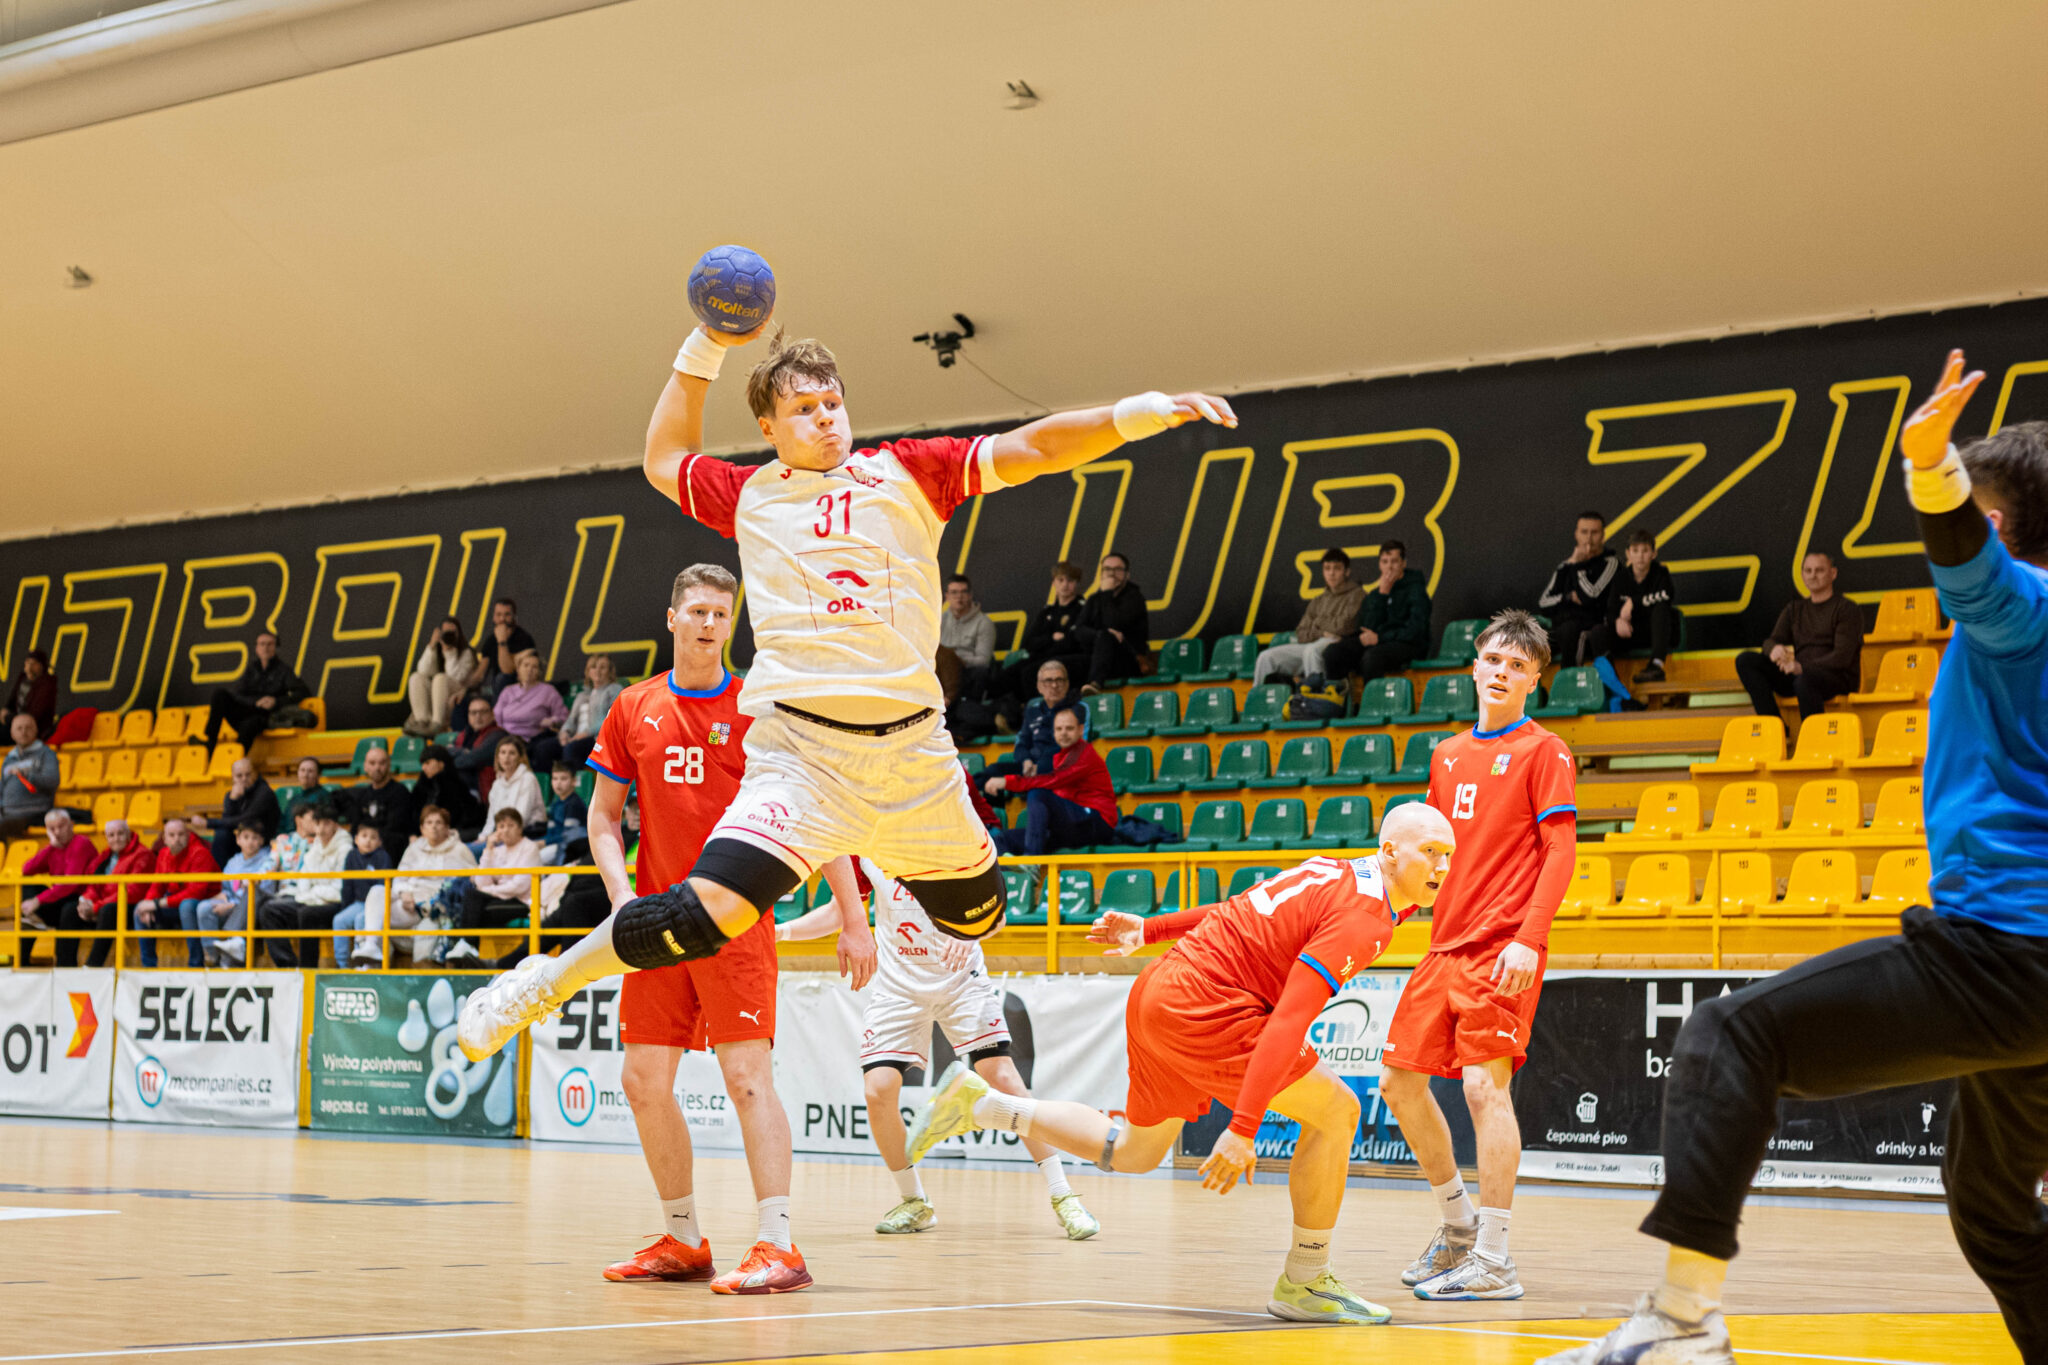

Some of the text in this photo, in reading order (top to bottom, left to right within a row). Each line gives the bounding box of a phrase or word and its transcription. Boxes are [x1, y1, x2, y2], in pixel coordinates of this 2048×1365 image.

[707, 295, 760, 318] molten
[1584, 360, 2048, 612] ZL
[813, 489, 851, 538] 31
[826, 596, 878, 615] ORL
[664, 746, 704, 785] 28
[1452, 783, 1478, 820] 19
[747, 813, 785, 832] ORLEN
[897, 946, 928, 956] ORLEN
[136, 986, 274, 1043] SELECT
[327, 992, 376, 1017] SEPAS
[322, 1054, 423, 1074] Výroba polystyrenu
[1314, 1047, 1384, 1061] MODU
[168, 1073, 272, 1096] mcompanies.cz
[320, 1099, 369, 1116] sepas.cz
[1546, 1129, 1628, 1147] čepované pivo
[1778, 1140, 1814, 1151] menu
[1876, 1141, 1917, 1158] drinky
[1919, 1145, 1927, 1156] a
